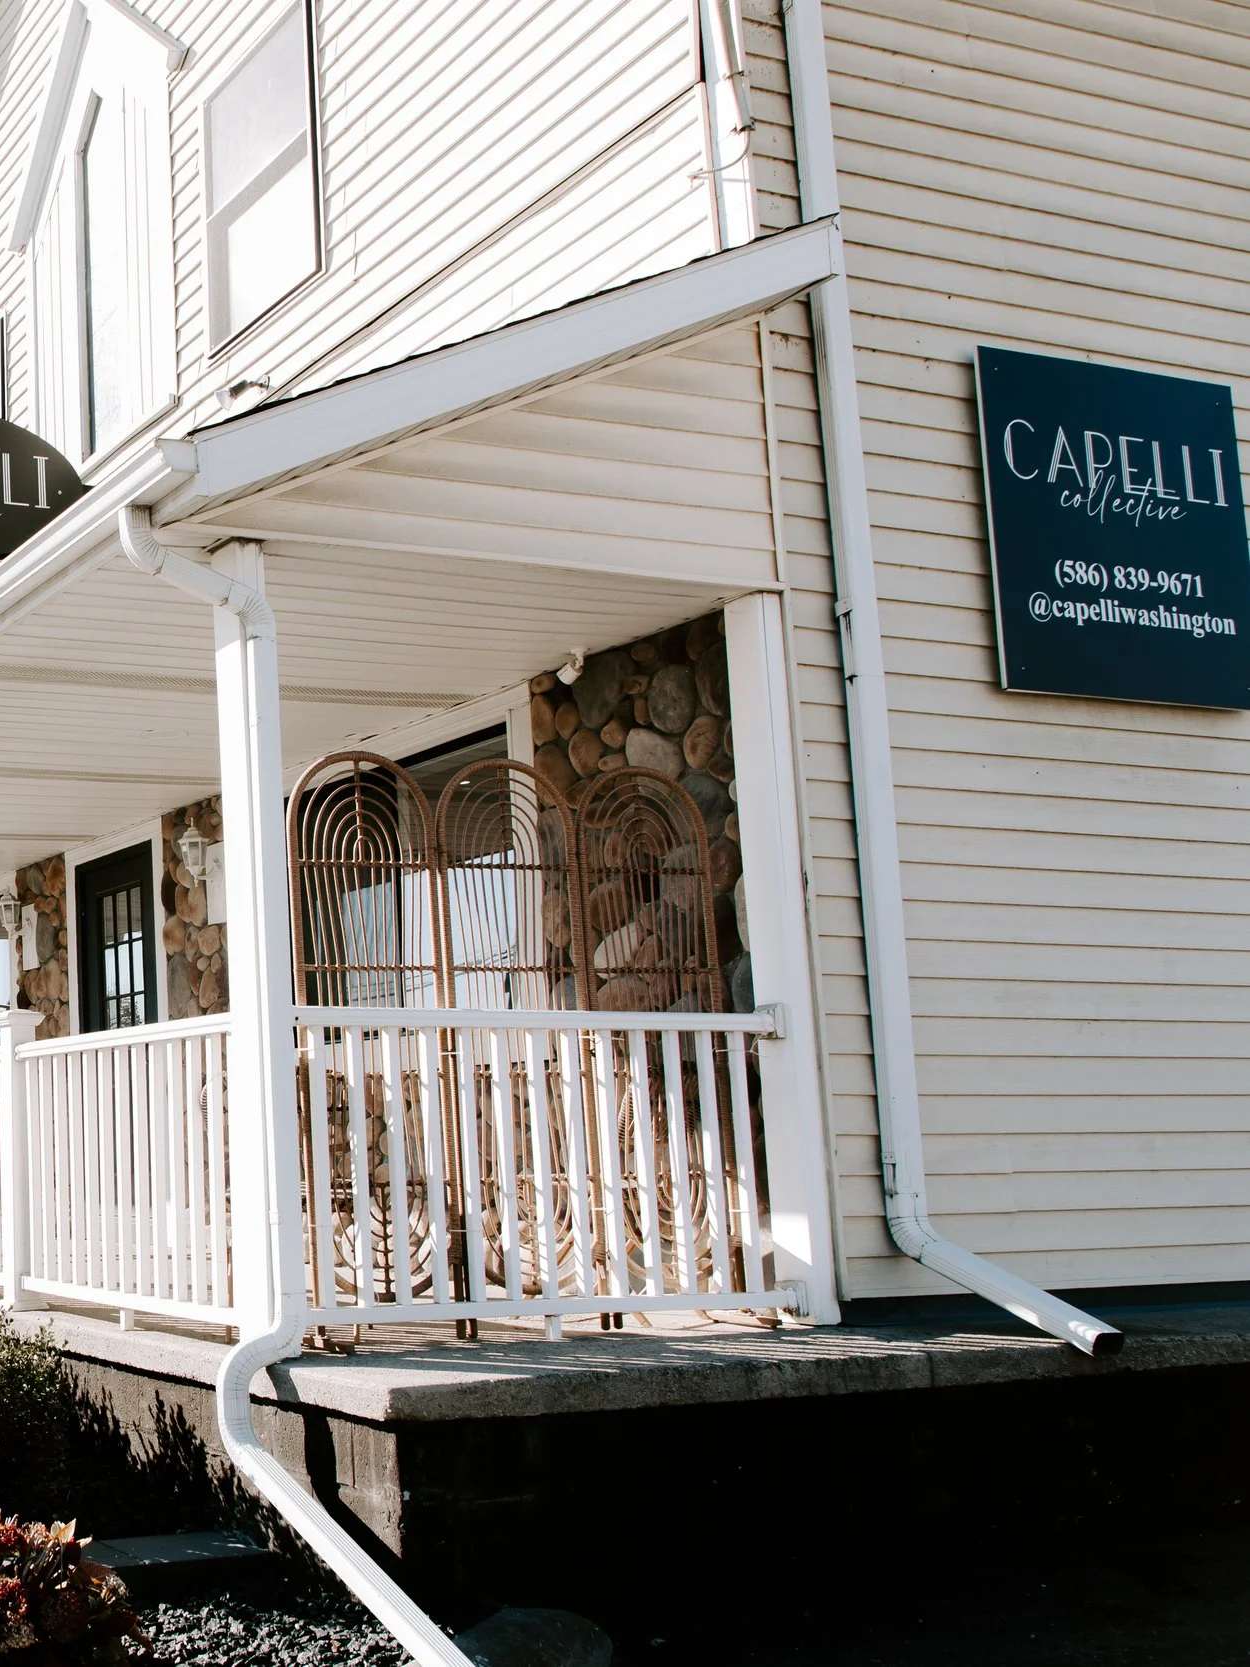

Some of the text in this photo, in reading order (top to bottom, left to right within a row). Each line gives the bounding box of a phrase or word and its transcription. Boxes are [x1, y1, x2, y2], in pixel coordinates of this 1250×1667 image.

[1003, 419, 1229, 507] CAPELLI
[1060, 470, 1188, 527] collective
[1054, 559, 1205, 598] (586) 839-9671
[1028, 591, 1237, 638] @capelliwashington
